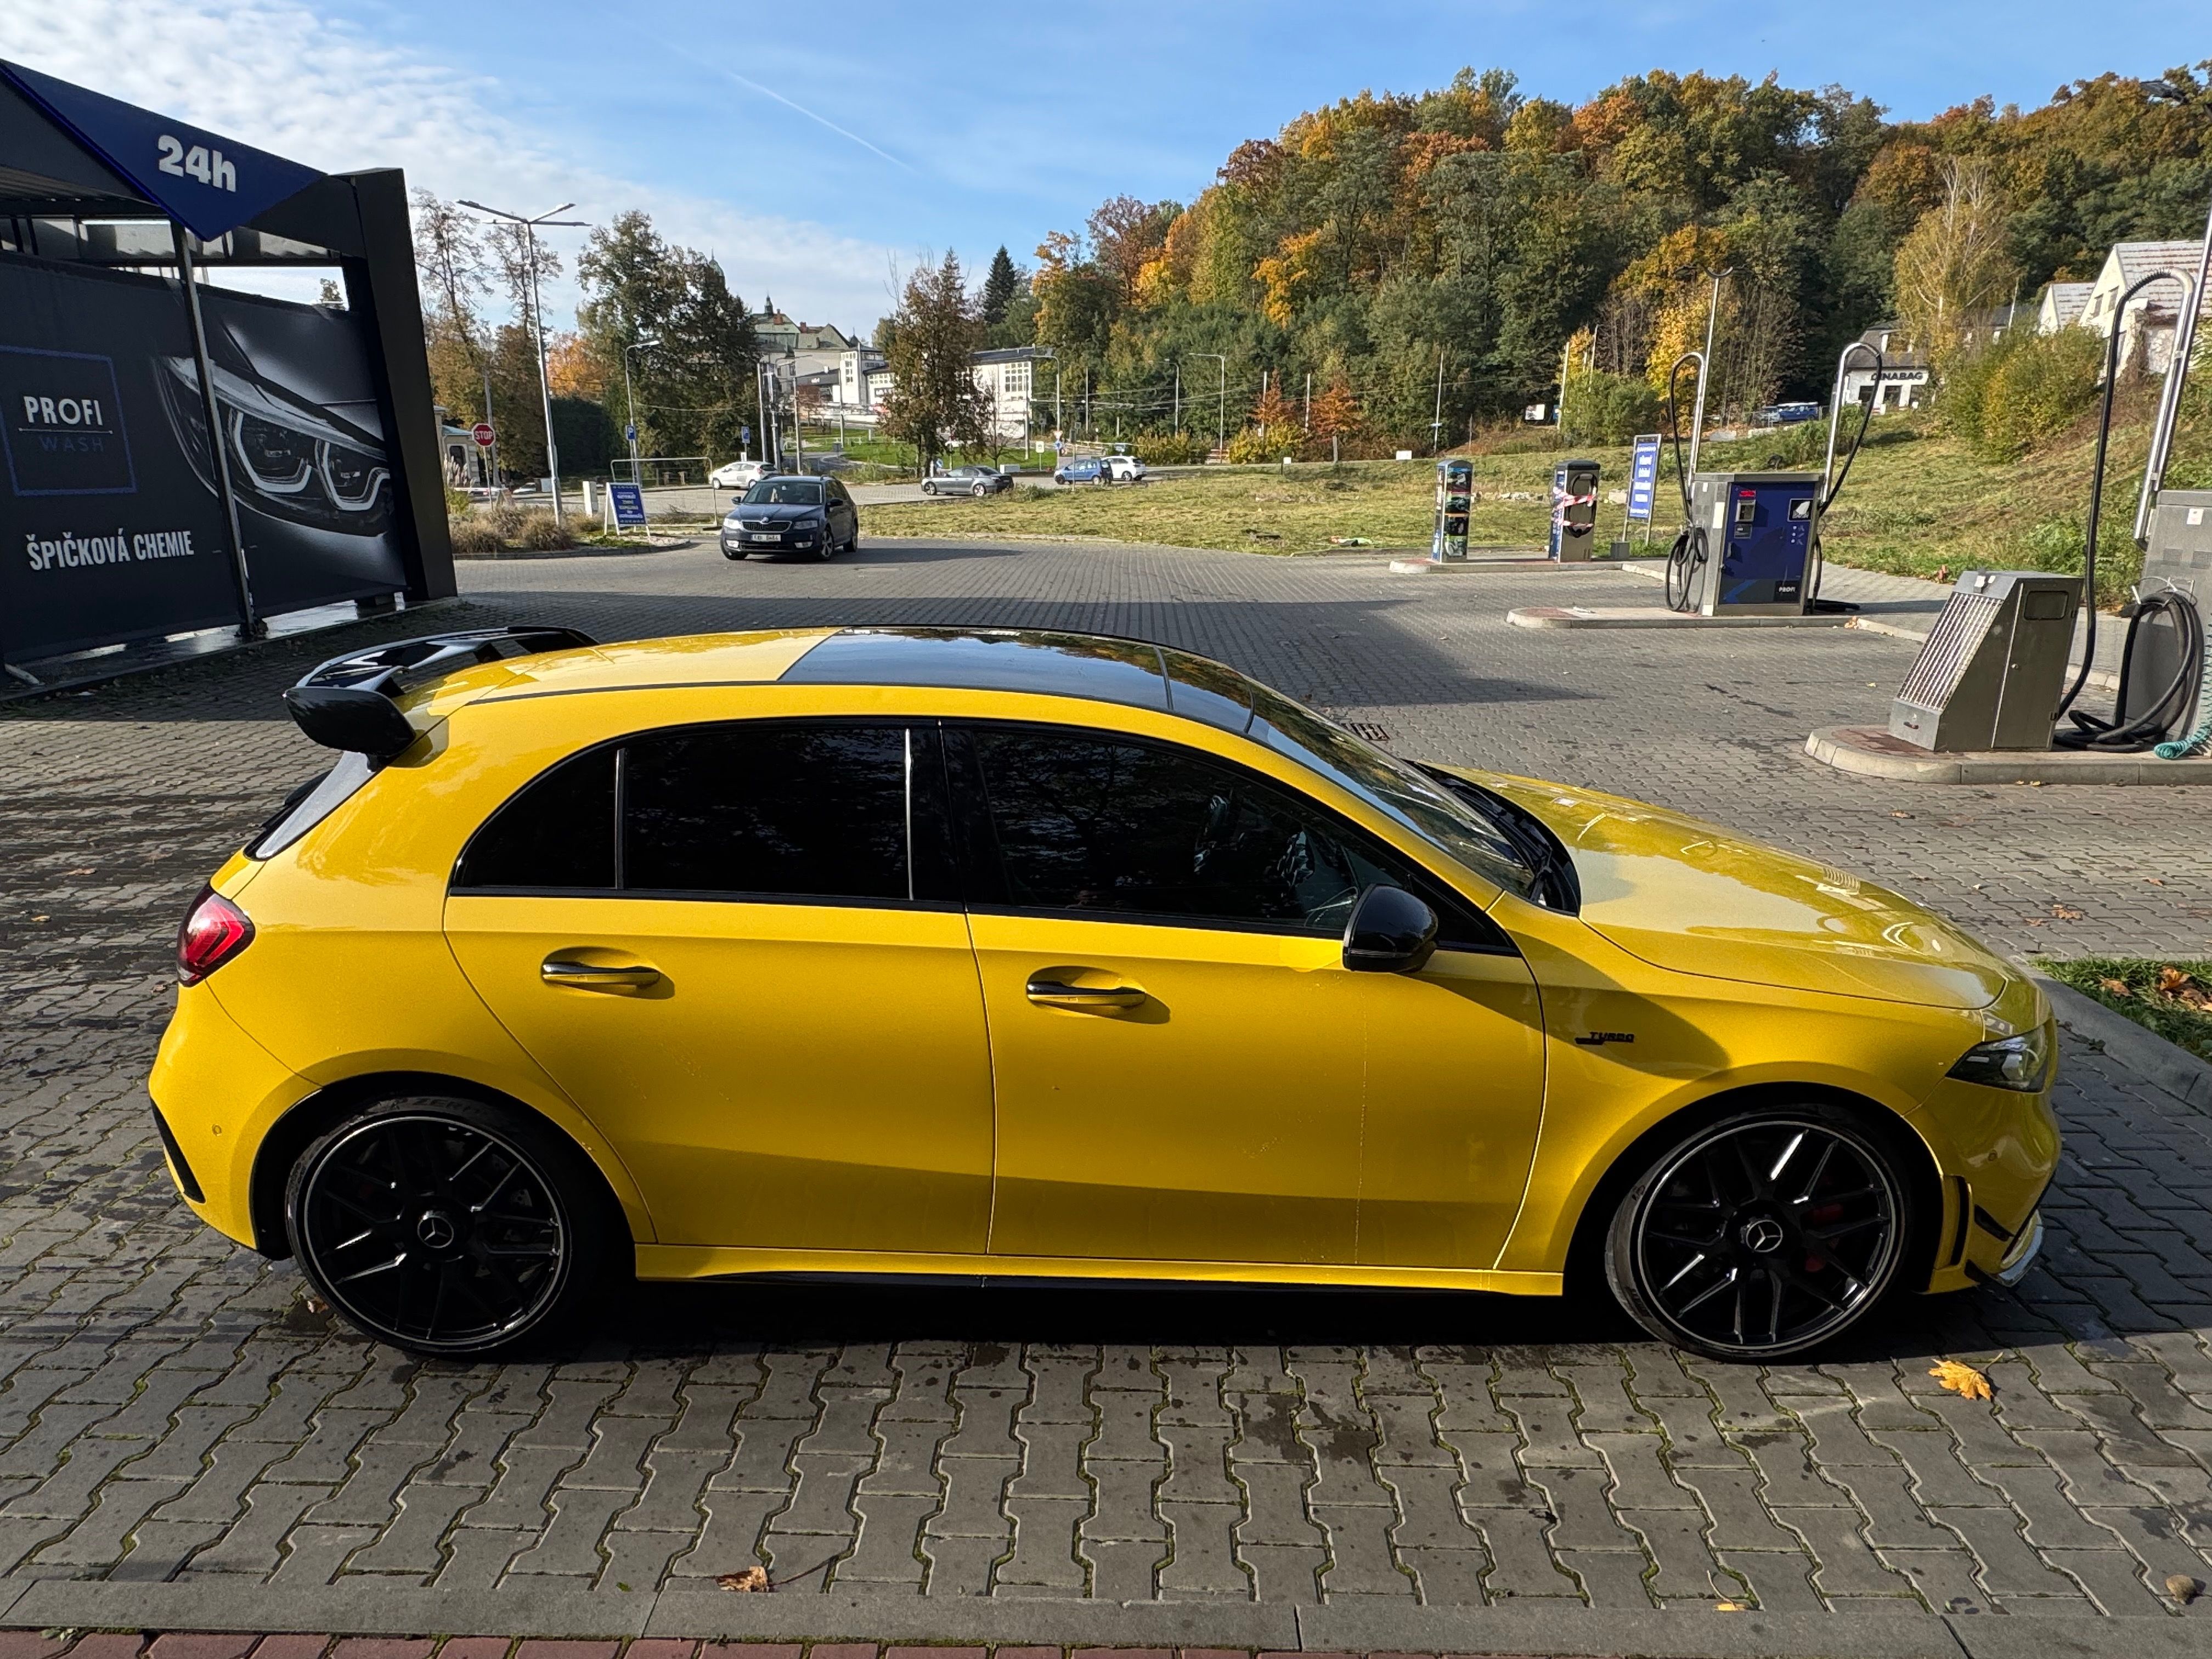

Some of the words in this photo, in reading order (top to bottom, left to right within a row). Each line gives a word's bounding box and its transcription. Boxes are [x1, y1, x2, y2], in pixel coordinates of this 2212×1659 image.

[158, 135, 236, 192] 24h
[23, 396, 103, 426] PROFI
[38, 436, 103, 452] WASH
[475, 431, 493, 439] STOP
[26, 528, 131, 571] ŠPIČKOVÁ
[133, 531, 194, 561] CHEMIE
[1589, 1031, 1634, 1043] TURBO
